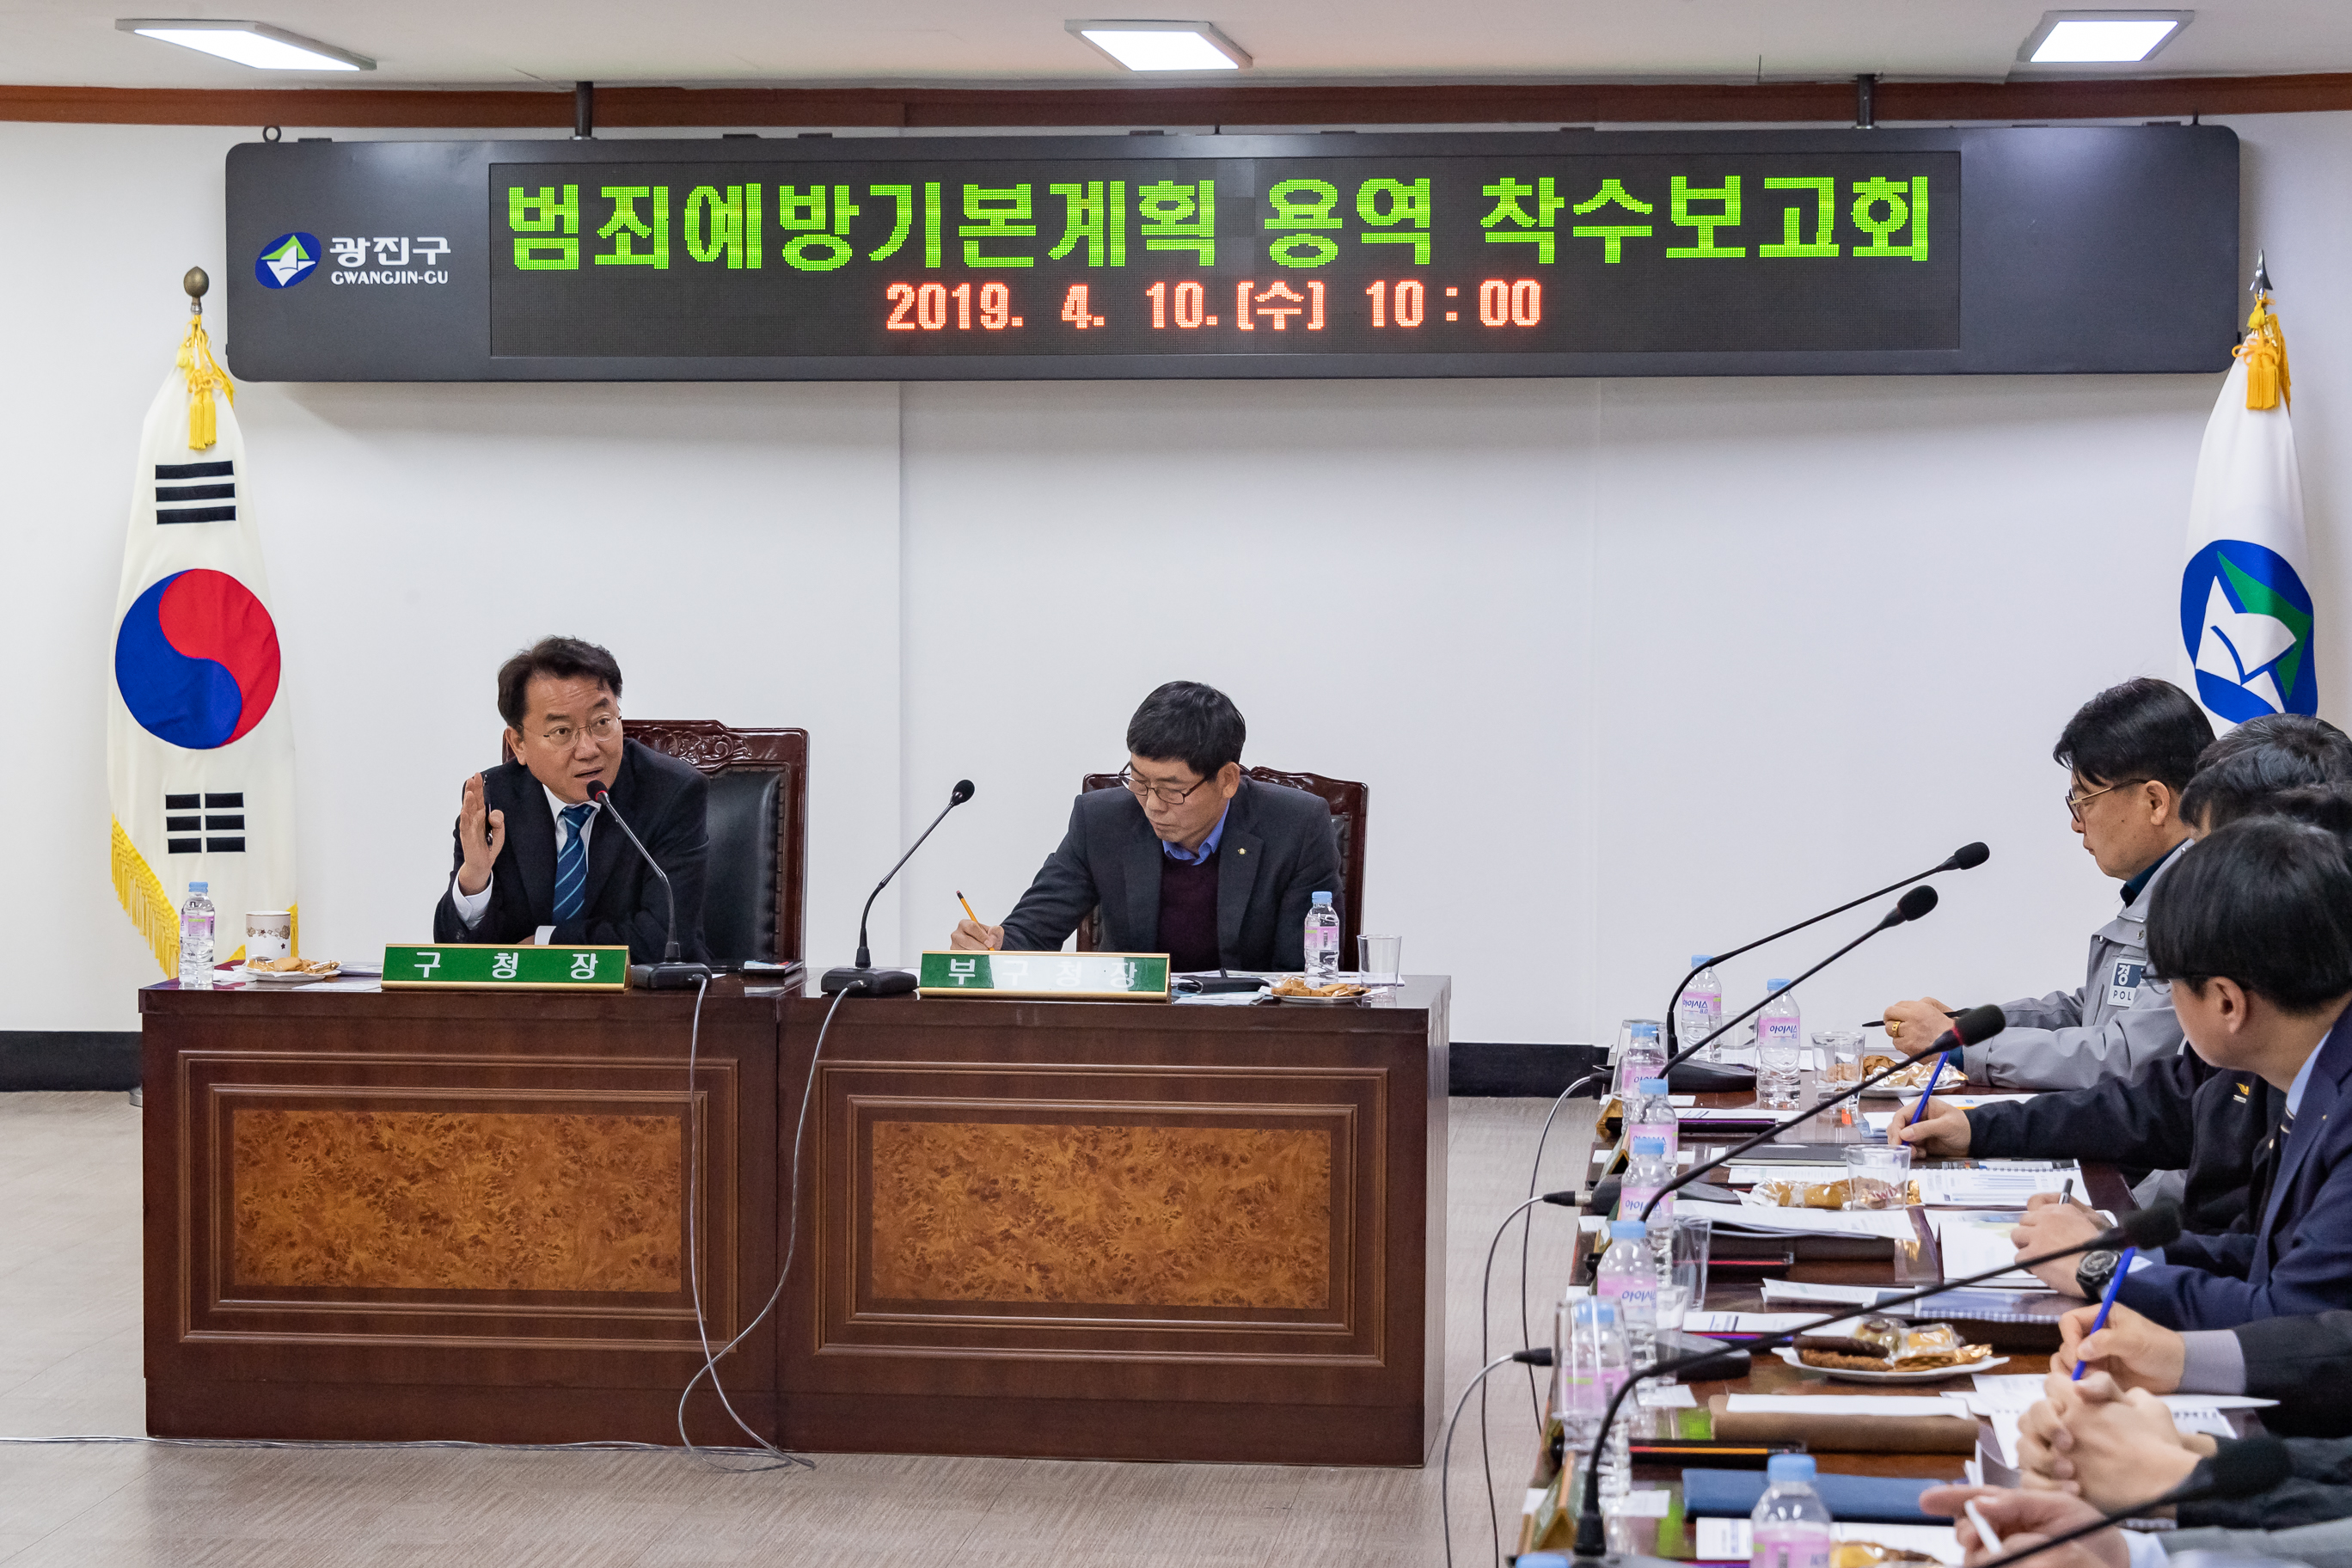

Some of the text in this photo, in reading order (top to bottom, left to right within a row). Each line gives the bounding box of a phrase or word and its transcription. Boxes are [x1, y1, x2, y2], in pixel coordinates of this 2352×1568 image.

[508, 175, 1928, 272] 범죄예방기본계획 용역 착수보고회
[329, 236, 451, 267] 광진구
[331, 270, 449, 285] GWANGJIN-GU
[885, 282, 1024, 330] 2019.
[1061, 284, 1106, 329] 4.
